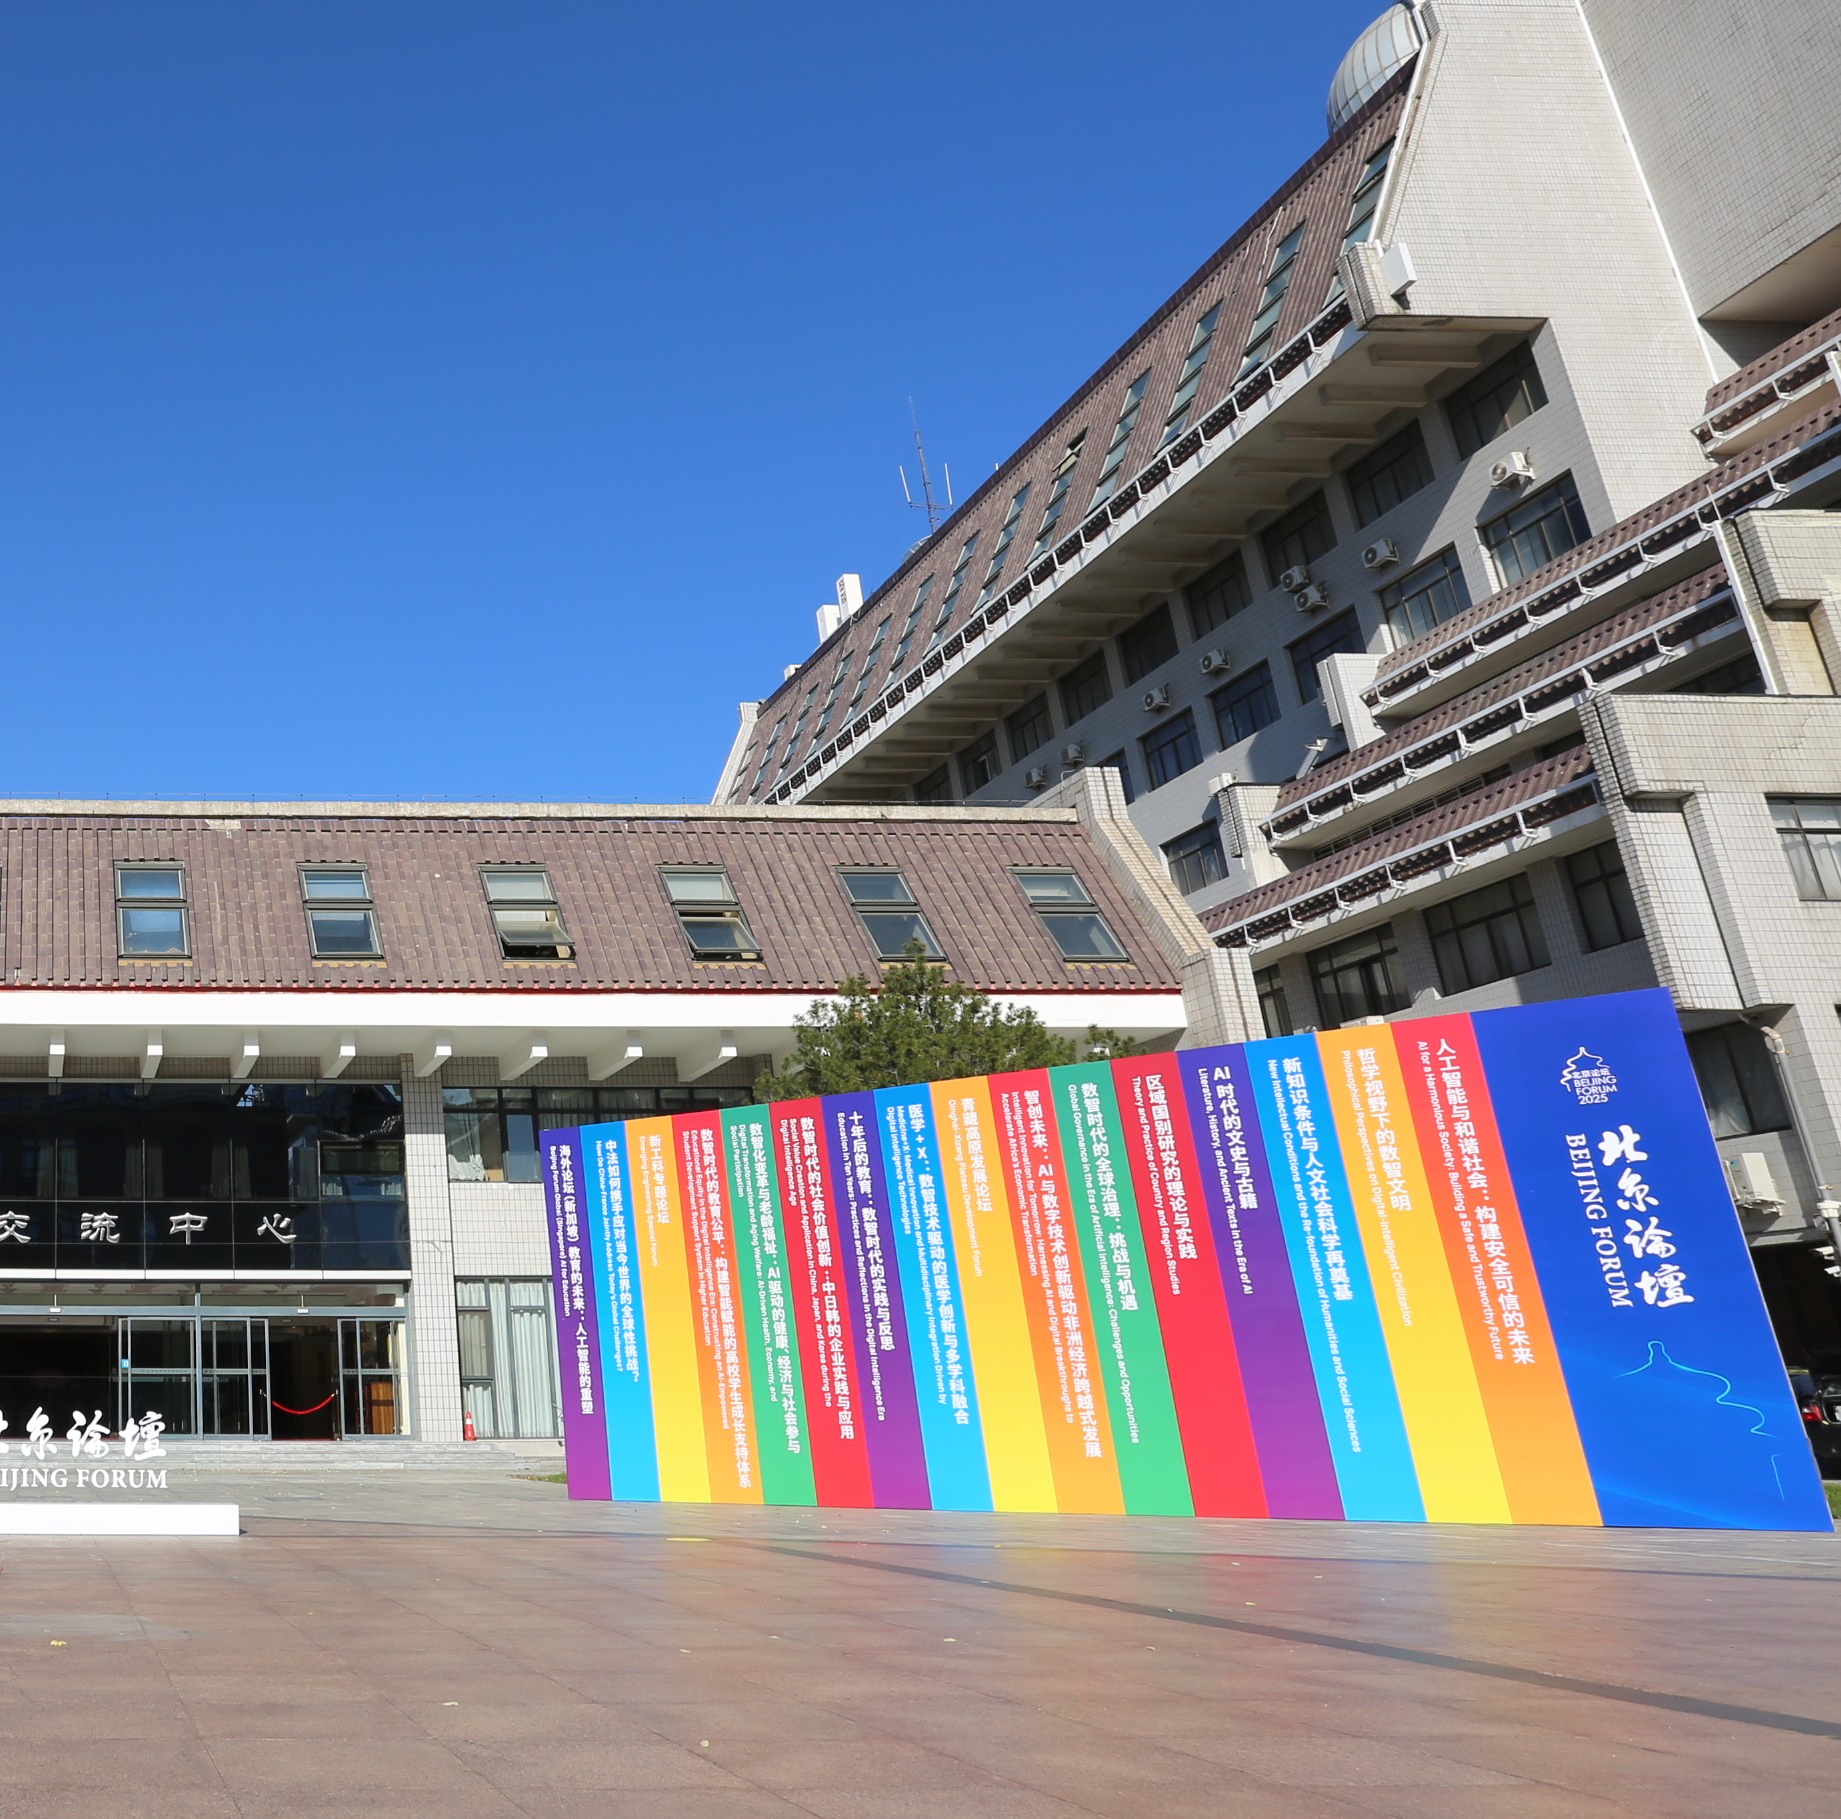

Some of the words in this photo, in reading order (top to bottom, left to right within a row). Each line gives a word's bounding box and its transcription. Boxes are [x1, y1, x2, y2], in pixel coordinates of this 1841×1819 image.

[1417, 1041, 1429, 1051] AI
[1420, 1051, 1431, 1065] for
[1267, 1059, 1279, 1079] New
[1573, 1075, 1617, 1087] BEIJING
[1068, 1084, 1081, 1112] Global
[1132, 1076, 1144, 1107] Theory
[1198, 1068, 1214, 1114] Literature,
[1425, 1073, 1446, 1130] Harmonious
[1576, 1085, 1618, 1096] FORUM
[1578, 1094, 1609, 1105] 2025
[1138, 1107, 1149, 1124] and
[1272, 1080, 1292, 1132] Intellectual
[837, 1112, 848, 1152] Education
[1073, 1111, 1089, 1163] Governance
[1141, 1124, 1155, 1161] Practice
[1208, 1114, 1221, 1149] History,
[1357, 1047, 1413, 1211] 哲学视野下的数智文明
[843, 1152, 850, 1161] in
[961, 1097, 994, 1212] 青藏高原发展论坛
[1214, 1150, 1227, 1167] and
[1283, 1131, 1301, 1183] Conditions
[1438, 1131, 1455, 1171] Society:
[649, 1135, 671, 1224] 新工科专题论坛
[844, 1161, 852, 1176] Ten
[1082, 1163, 1091, 1173] in
[1084, 1172, 1093, 1189] the
[1145, 1074, 1198, 1259] 区域国别研究的理论与实践
[1148, 1162, 1158, 1171] of
[1282, 1056, 1353, 1301] 新知识条件与人文社会科学再奠基
[846, 1176, 855, 1201] Years:
[1087, 1189, 1096, 1204] Era
[1150, 1172, 1164, 1208] Country
[1218, 1168, 1234, 1203] Ancient
[1294, 1183, 1307, 1201] and
[1448, 1172, 1466, 1212] Building
[849, 1201, 861, 1239] Practices
[1089, 1204, 1099, 1214] of
[1157, 1209, 1169, 1226] and
[1226, 1203, 1238, 1229] Texts
[1298, 1201, 1309, 1219] the
[1565, 1133, 1608, 1220] BEIJING
[1590, 1226, 1634, 1308] FORUM
[1091, 1215, 1106, 1252] Artificial
[1160, 1227, 1173, 1259] Region
[1231, 1230, 1241, 1239] in
[1460, 1220, 1475, 1243] Safe
[854, 1240, 864, 1256] and
[1233, 1239, 1243, 1256] the
[1302, 1219, 1324, 1287] Re-foundation
[1466, 1244, 1481, 1263] and
[1167, 1260, 1181, 1295] Studies
[1236, 1257, 1247, 1273] Era
[1240, 1273, 1251, 1284] of
[857, 1256, 869, 1303] Reflections
[1098, 1253, 1114, 1308] Intelligence:
[1242, 1284, 1254, 1294] AI
[1317, 1288, 1329, 1299] of
[863, 1304, 871, 1312] in
[1472, 1264, 1495, 1326] Trustworthy
[864, 1313, 873, 1328] the
[1108, 1308, 1124, 1360] Challenges
[1320, 1299, 1339, 1355] Humanities
[866, 1328, 878, 1356] Digital
[1488, 1326, 1505, 1360] Future
[1118, 1360, 1129, 1378] and
[1332, 1356, 1346, 1375] and
[870, 1356, 883, 1406] Intelligence
[1336, 1376, 1353, 1406] Social
[877, 1407, 885, 1421] Era
[1120, 1378, 1139, 1444] Opportunities
[1344, 1407, 1362, 1453] Sciences
[76, 1468, 168, 1489] FORUM
